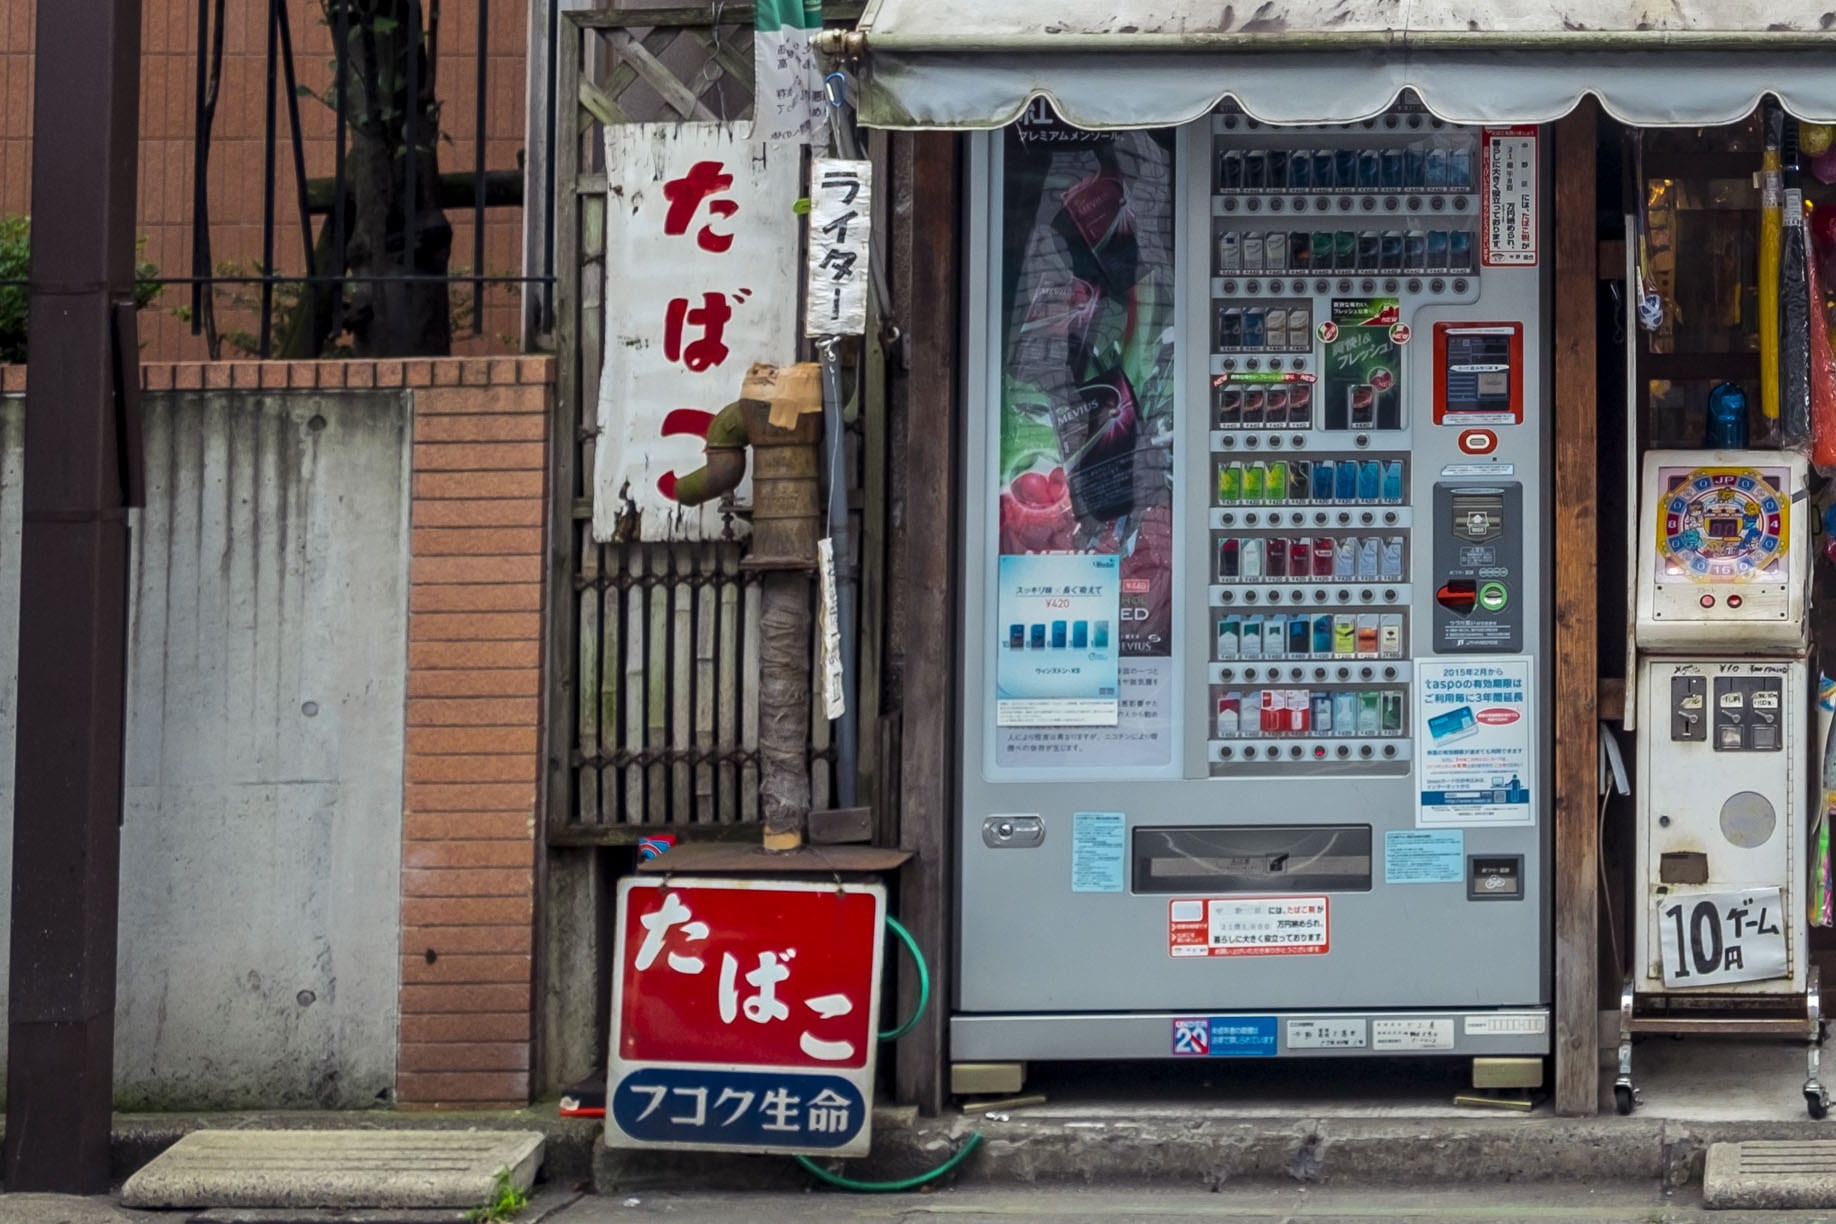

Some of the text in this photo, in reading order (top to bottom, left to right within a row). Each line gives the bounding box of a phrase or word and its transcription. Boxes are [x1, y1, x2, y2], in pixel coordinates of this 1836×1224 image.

[818, 170, 861, 321] ライター
[1057, 397, 1100, 428] MEVIUS
[1715, 475, 1735, 485] JP
[1045, 598, 1071, 609] ¥420
[1120, 608, 1150, 621] ED
[1121, 642, 1153, 652] EVIUS
[1443, 668, 1505, 678] 2015年2月から
[1425, 678, 1523, 692] taspoの有効期限は
[1424, 691, 1524, 704] ご利用毎に3年間延長
[1726, 896, 1779, 938] ゲーム
[1214, 933, 1325, 944] 暮らしに大きく役立っております。
[1666, 900, 1723, 978] 10
[634, 891, 855, 1061] たばこ
[1175, 1028, 1209, 1054] 20
[628, 1085, 853, 1134] フコク生命
